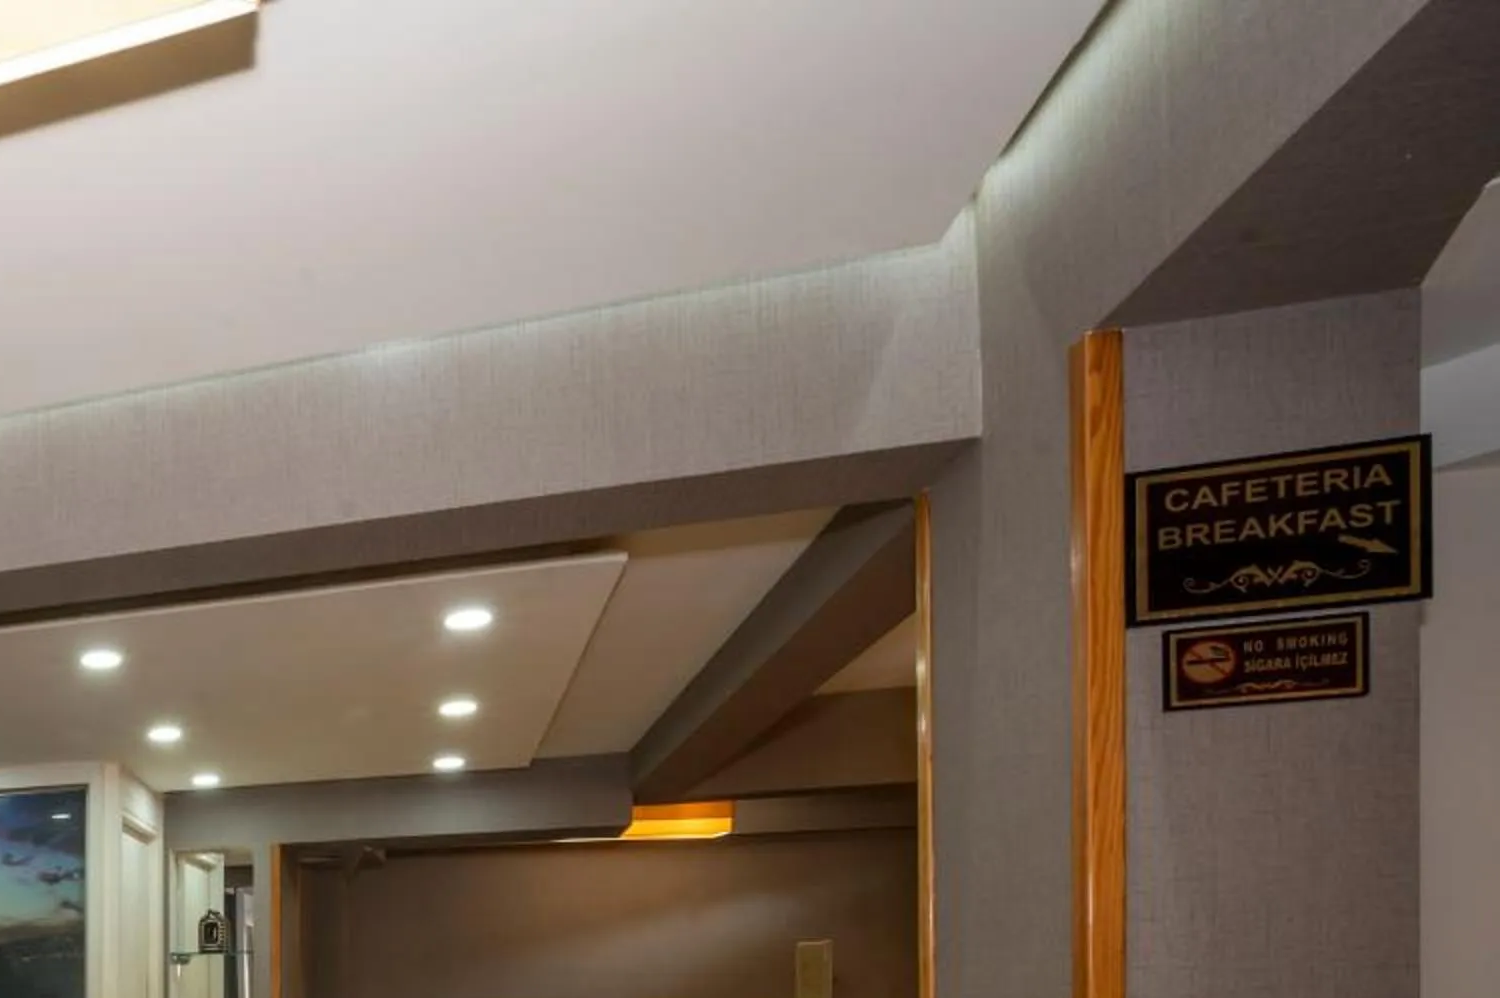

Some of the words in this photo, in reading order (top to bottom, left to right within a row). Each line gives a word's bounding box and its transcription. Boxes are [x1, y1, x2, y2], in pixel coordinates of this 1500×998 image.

[1164, 463, 1393, 513] CAFETERIA
[1157, 500, 1402, 551] BREAKFAST
[1243, 639, 1264, 653] NO
[1277, 631, 1349, 651] SMOKING
